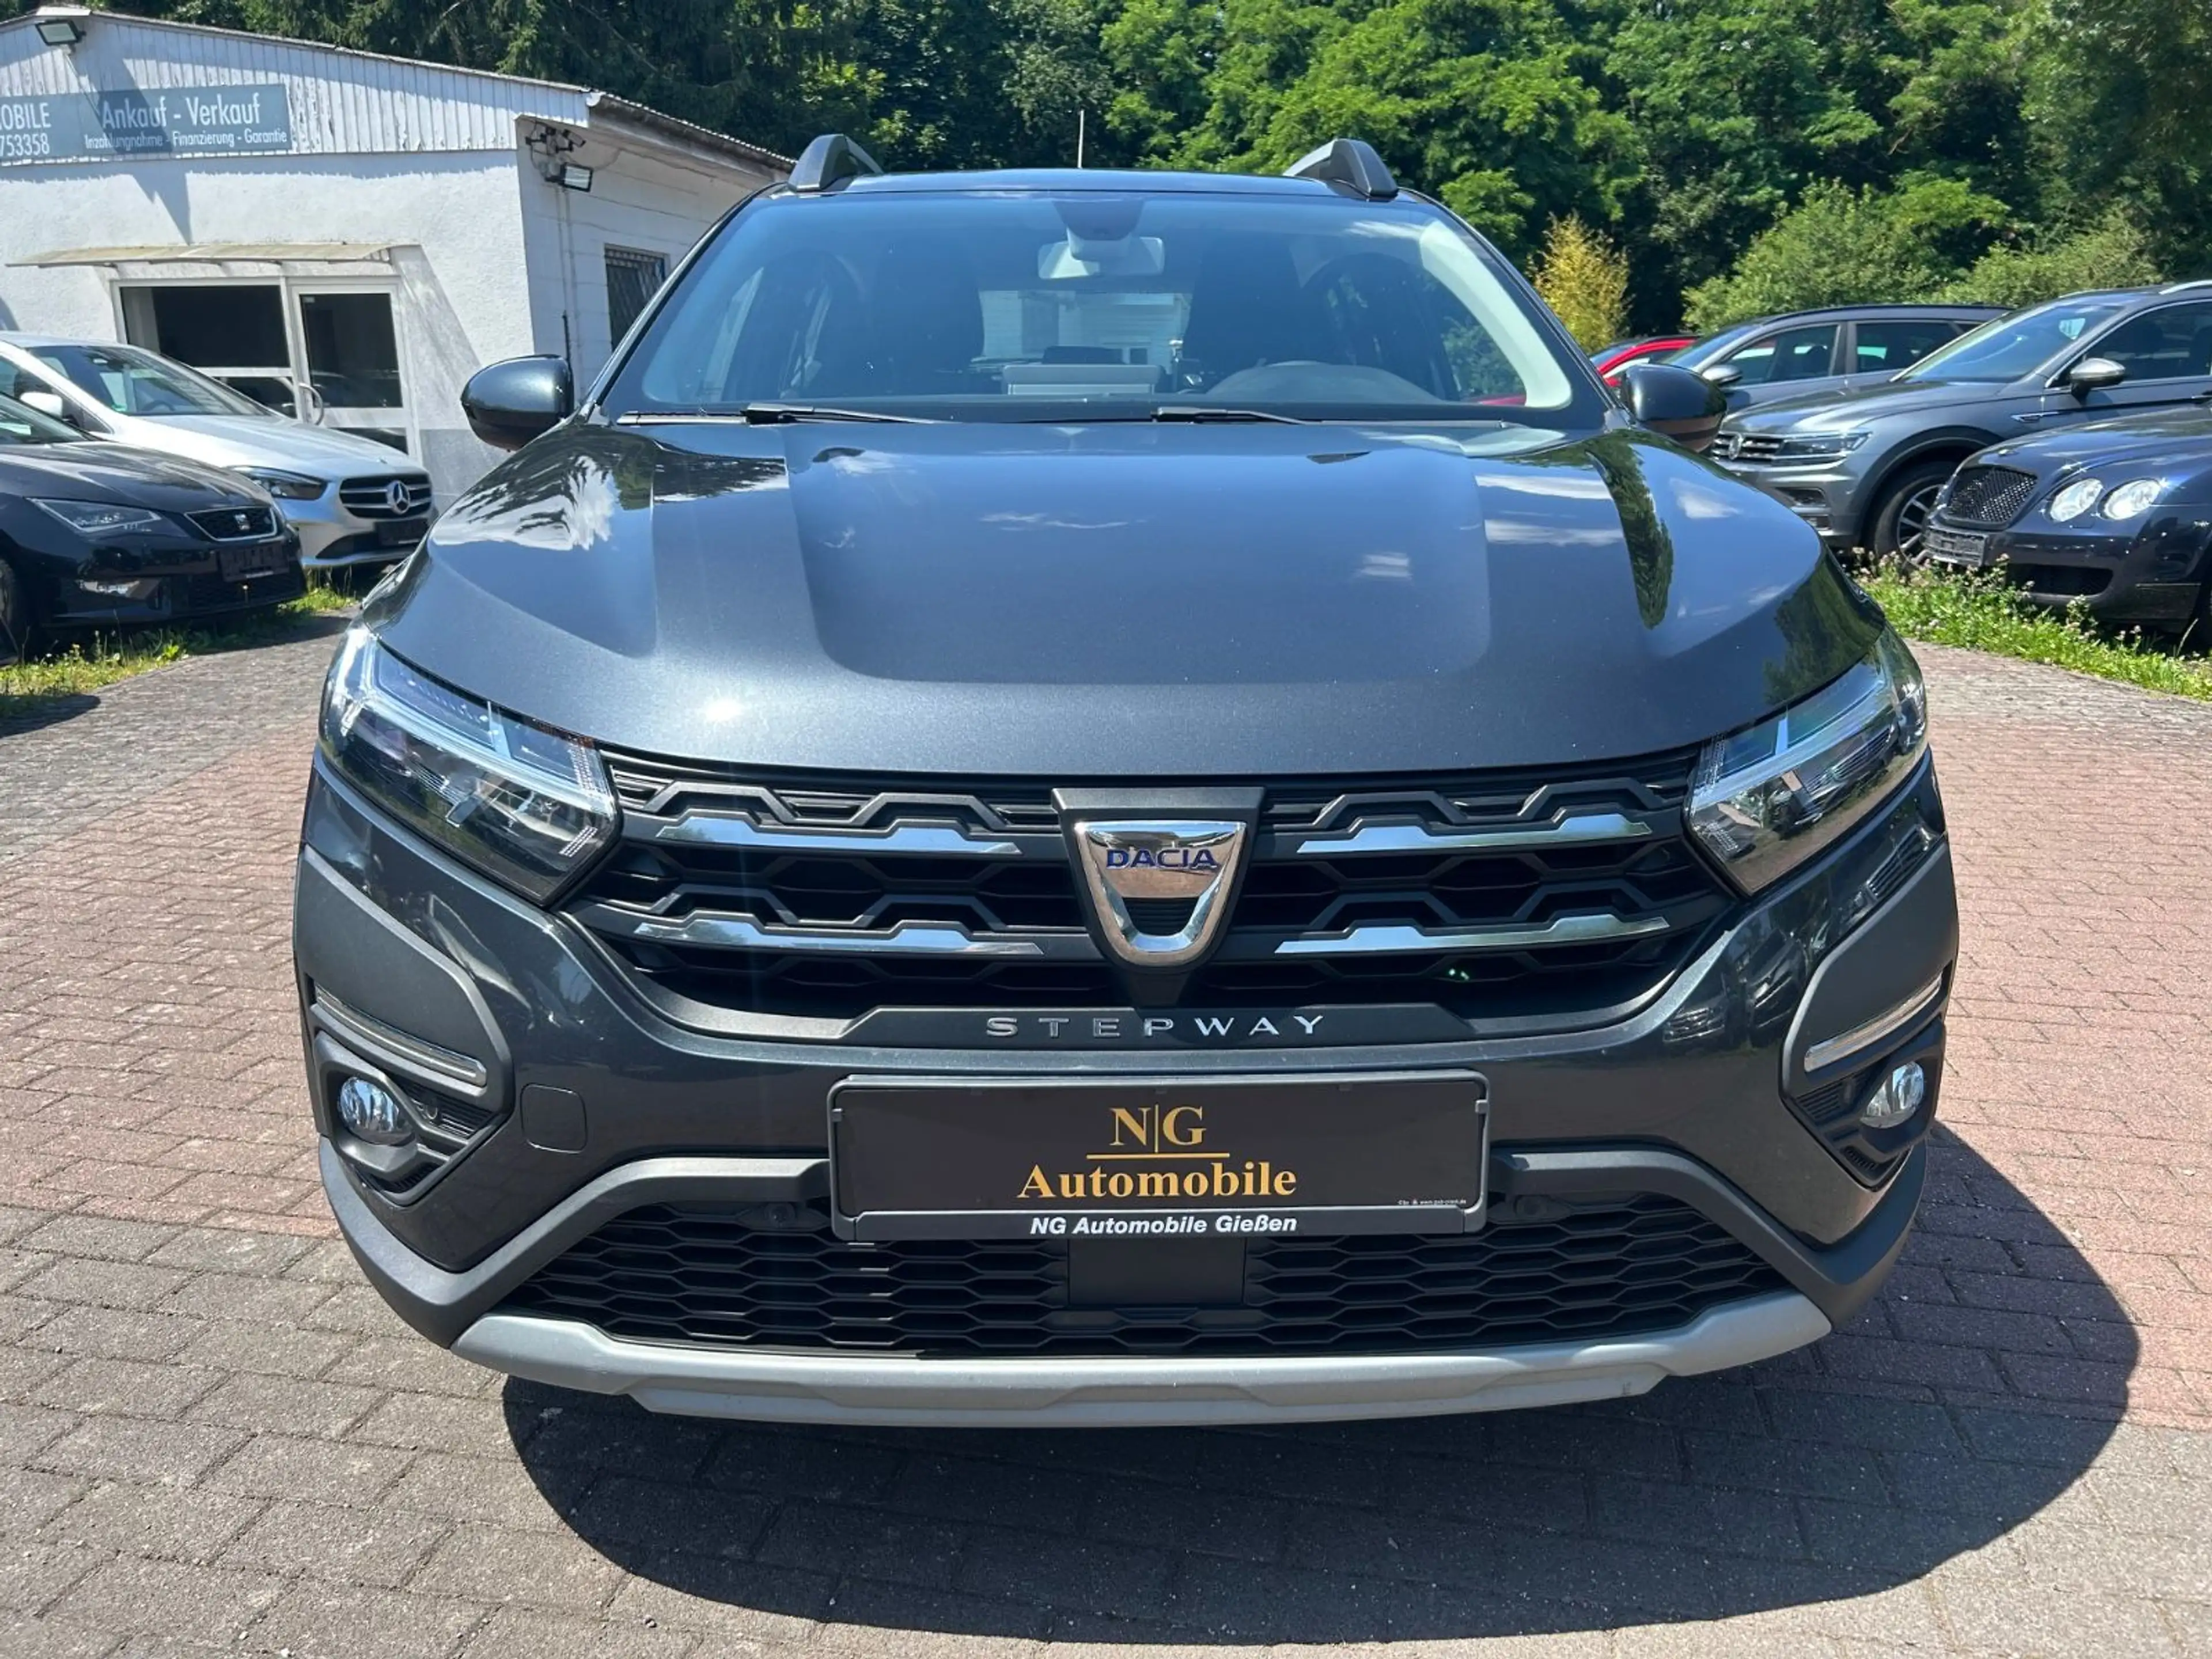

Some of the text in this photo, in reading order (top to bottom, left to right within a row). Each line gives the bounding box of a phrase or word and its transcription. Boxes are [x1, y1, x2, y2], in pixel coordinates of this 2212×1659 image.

[0, 102, 52, 130] OBILE
[103, 96, 166, 129] Ankauf
[185, 92, 260, 126] Verkauf
[172, 129, 234, 147] Finanzierung
[244, 127, 287, 143] Garantie
[1105, 849, 1218, 869] DACIA
[986, 1015, 1324, 1037] STEPWAY
[1017, 1161, 1298, 1198] Automobile
[1030, 1214, 1298, 1235] NG Automobile Gießen
